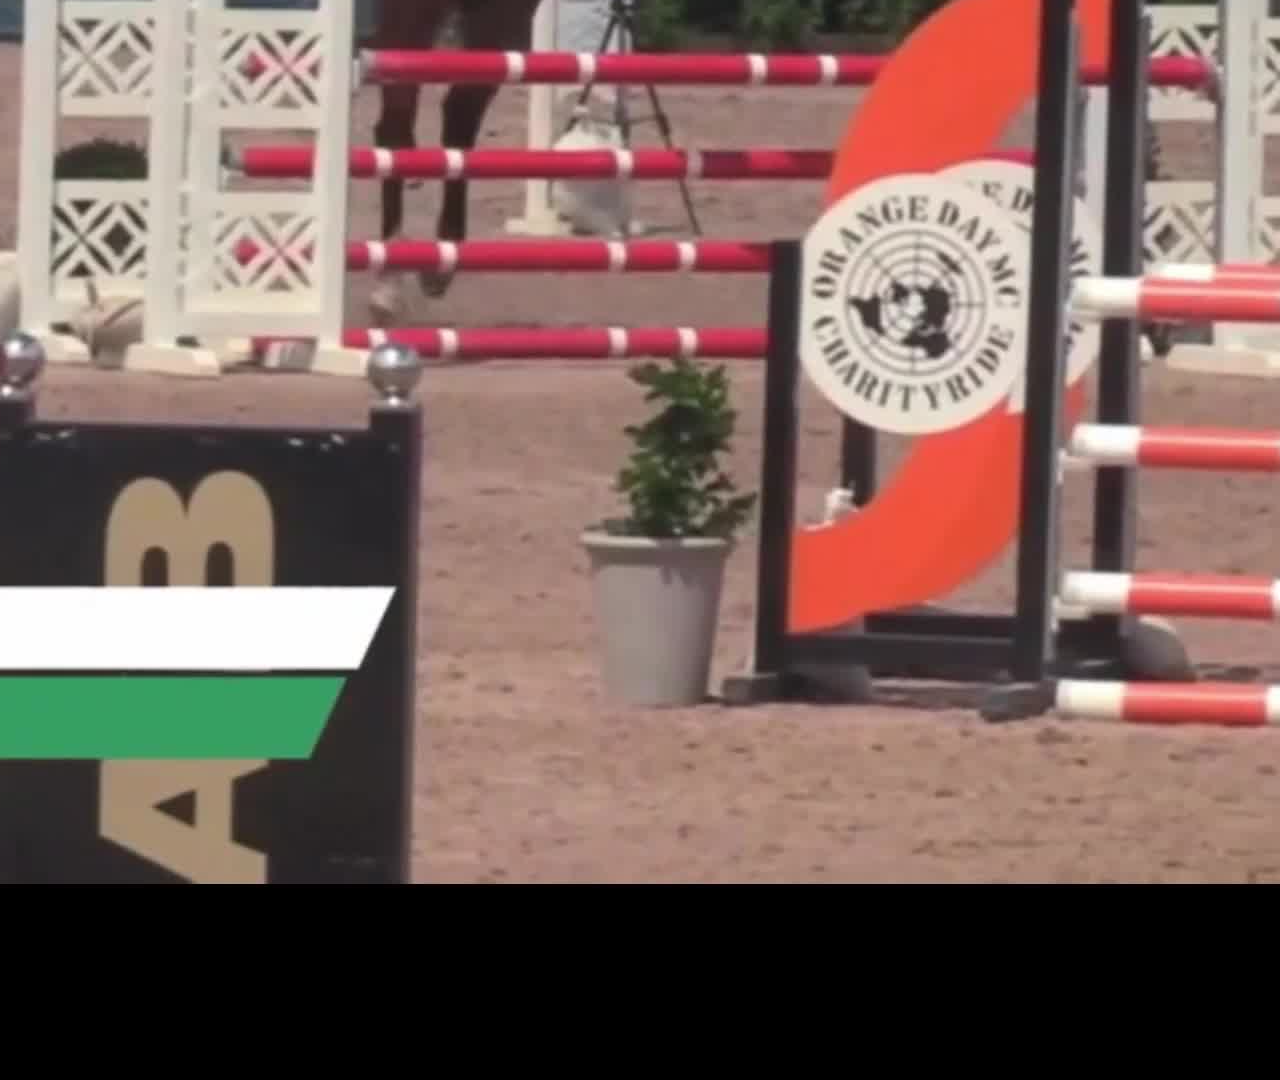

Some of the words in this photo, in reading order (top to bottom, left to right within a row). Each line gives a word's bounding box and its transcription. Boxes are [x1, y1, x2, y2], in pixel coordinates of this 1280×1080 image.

[812, 195, 929, 300] ORANGE
[936, 199, 1004, 253] DAY
[986, 254, 1021, 309] MC
[811, 315, 1016, 412] CHARITYRIDE
